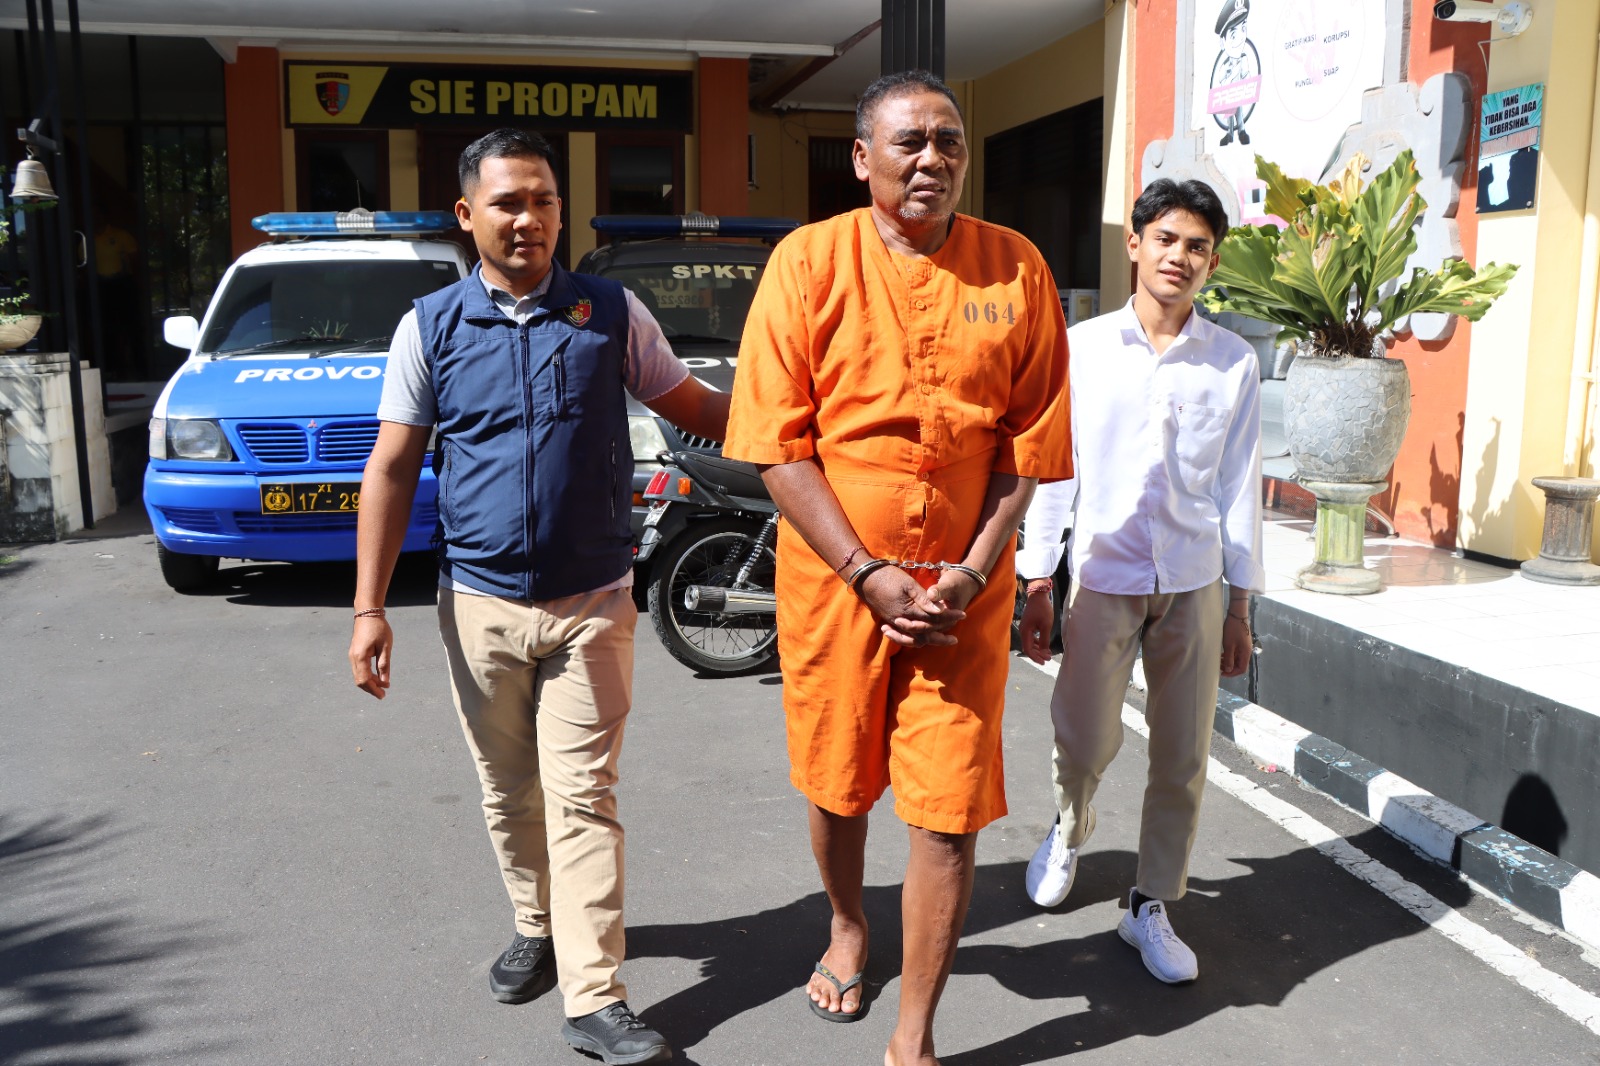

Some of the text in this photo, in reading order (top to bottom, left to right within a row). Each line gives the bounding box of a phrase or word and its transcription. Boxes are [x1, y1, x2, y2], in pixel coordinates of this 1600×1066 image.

[1284, 33, 1317, 50] GRATIFIKASI
[1323, 30, 1350, 44] KORUPSI
[1323, 65, 1340, 77] SUAP
[410, 79, 658, 119] SIE PROPAM
[1502, 94, 1519, 107] YANG
[1485, 100, 1537, 125] TIDAK BISA JAGA
[672, 264, 757, 280] SPKT
[963, 301, 1016, 325] 064
[234, 365, 386, 383] PROVO
[317, 484, 332, 493] XI
